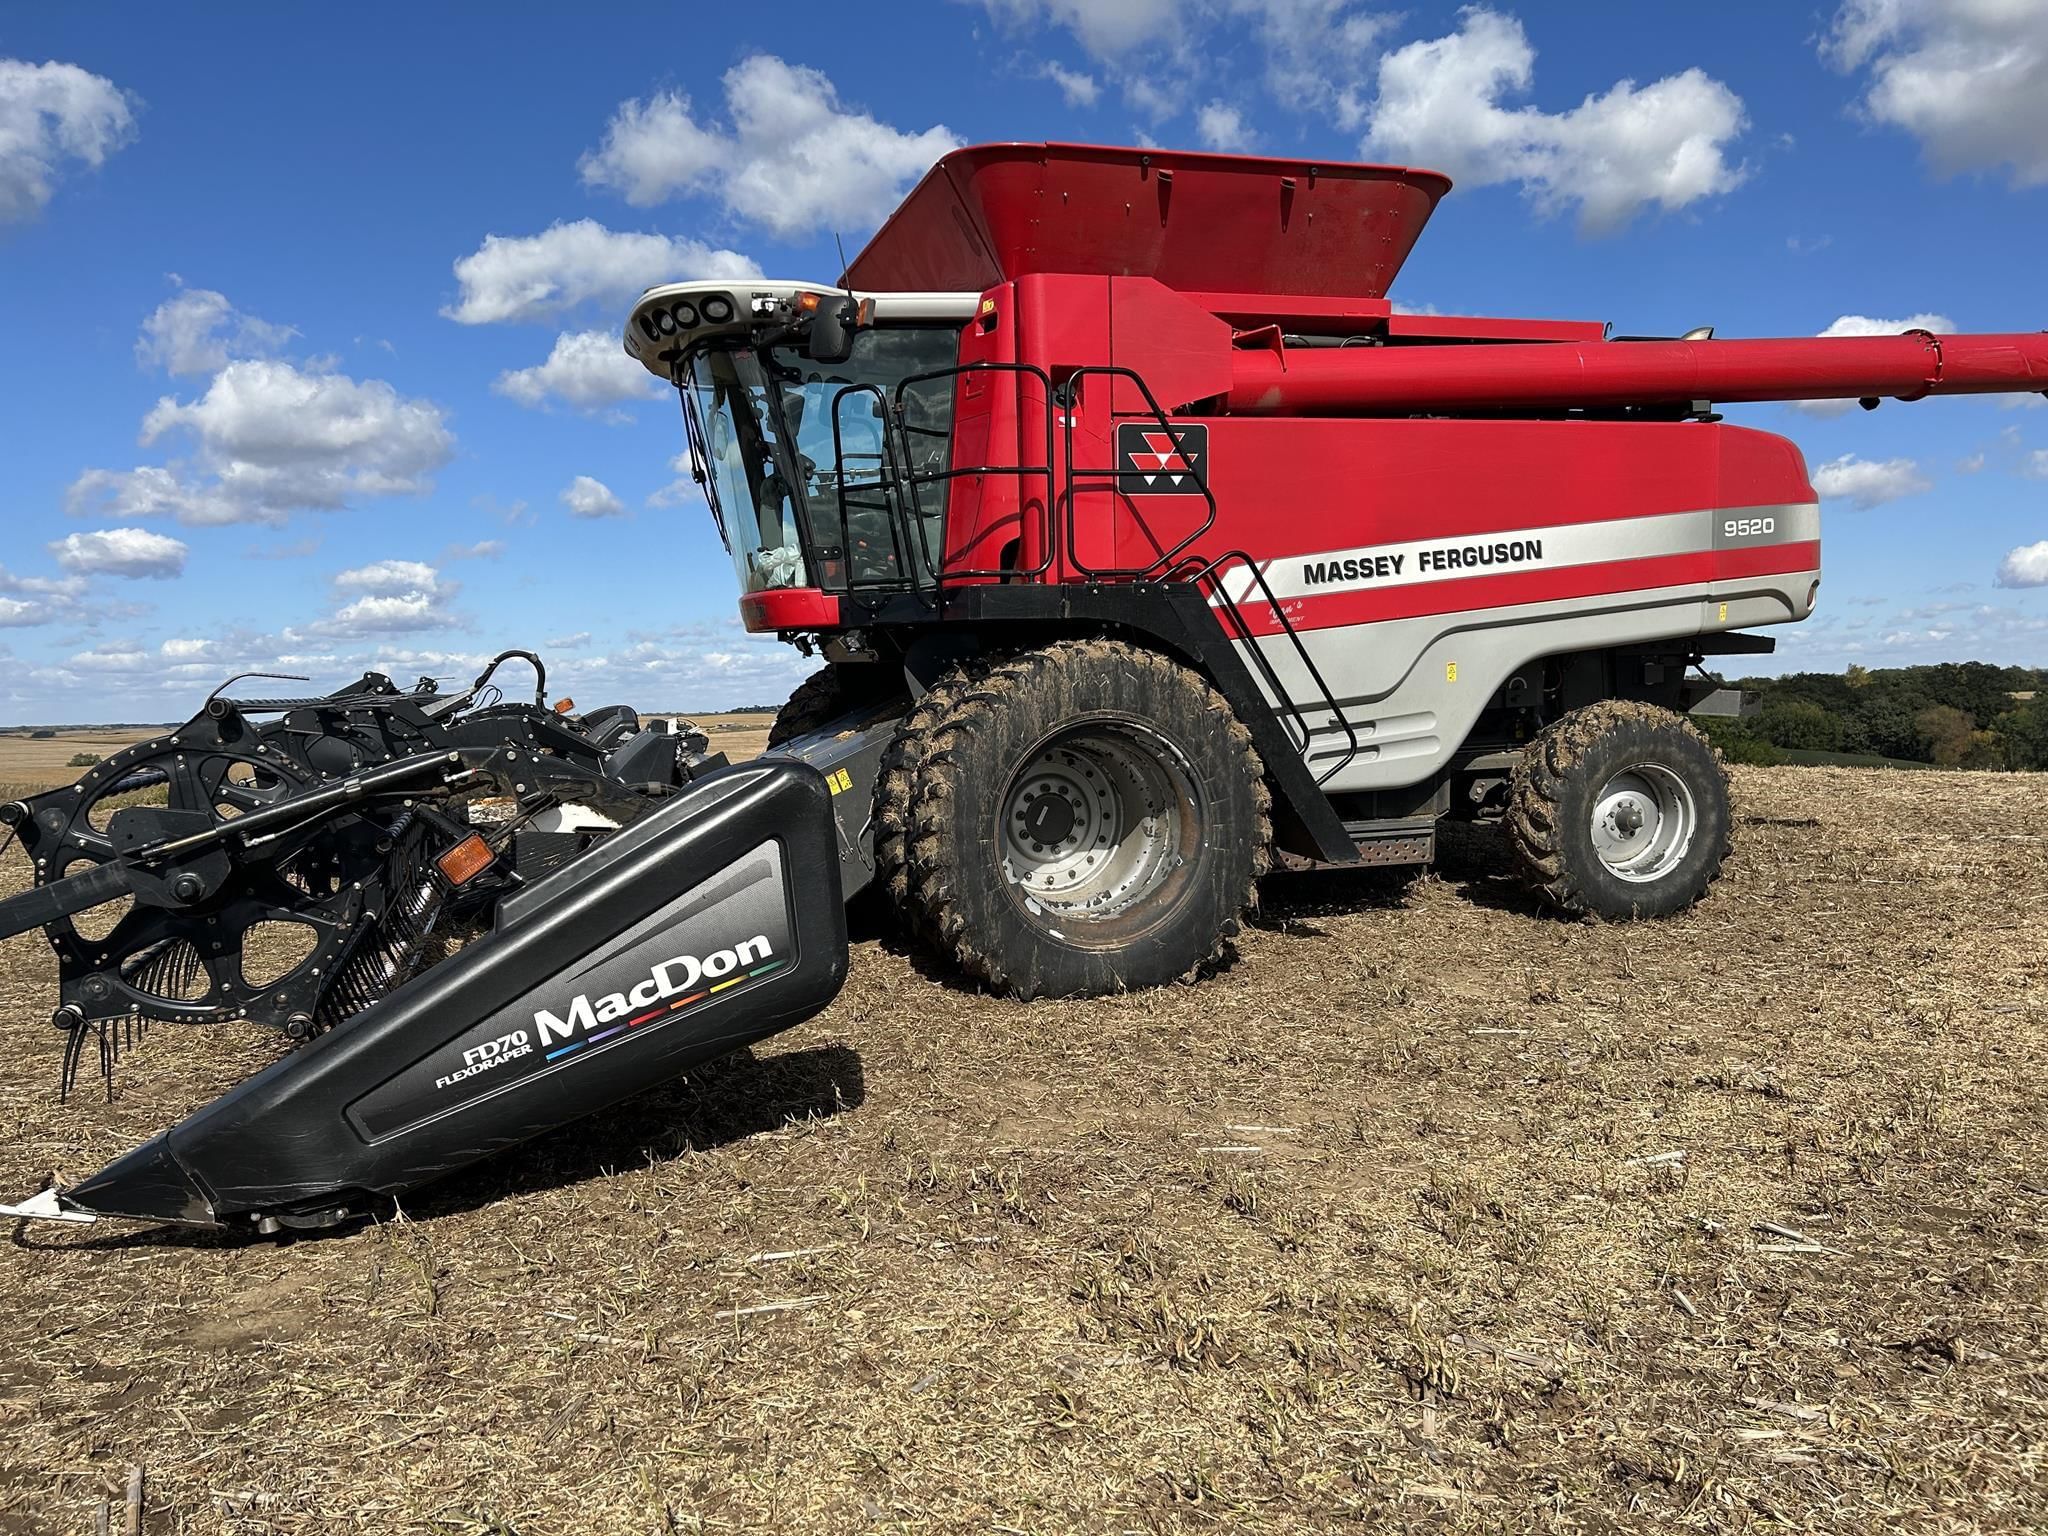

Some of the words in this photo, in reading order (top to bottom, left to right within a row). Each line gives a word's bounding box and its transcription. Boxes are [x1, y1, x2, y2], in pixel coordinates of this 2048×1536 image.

[1724, 517, 1775, 537] 9520
[1303, 553, 1405, 585] MASSEY
[1418, 539, 1543, 573] FERGUSON
[533, 934, 774, 1047] MacDon
[435, 1043, 534, 1089] FLEXDRAPER
[462, 1030, 528, 1067] FD70
